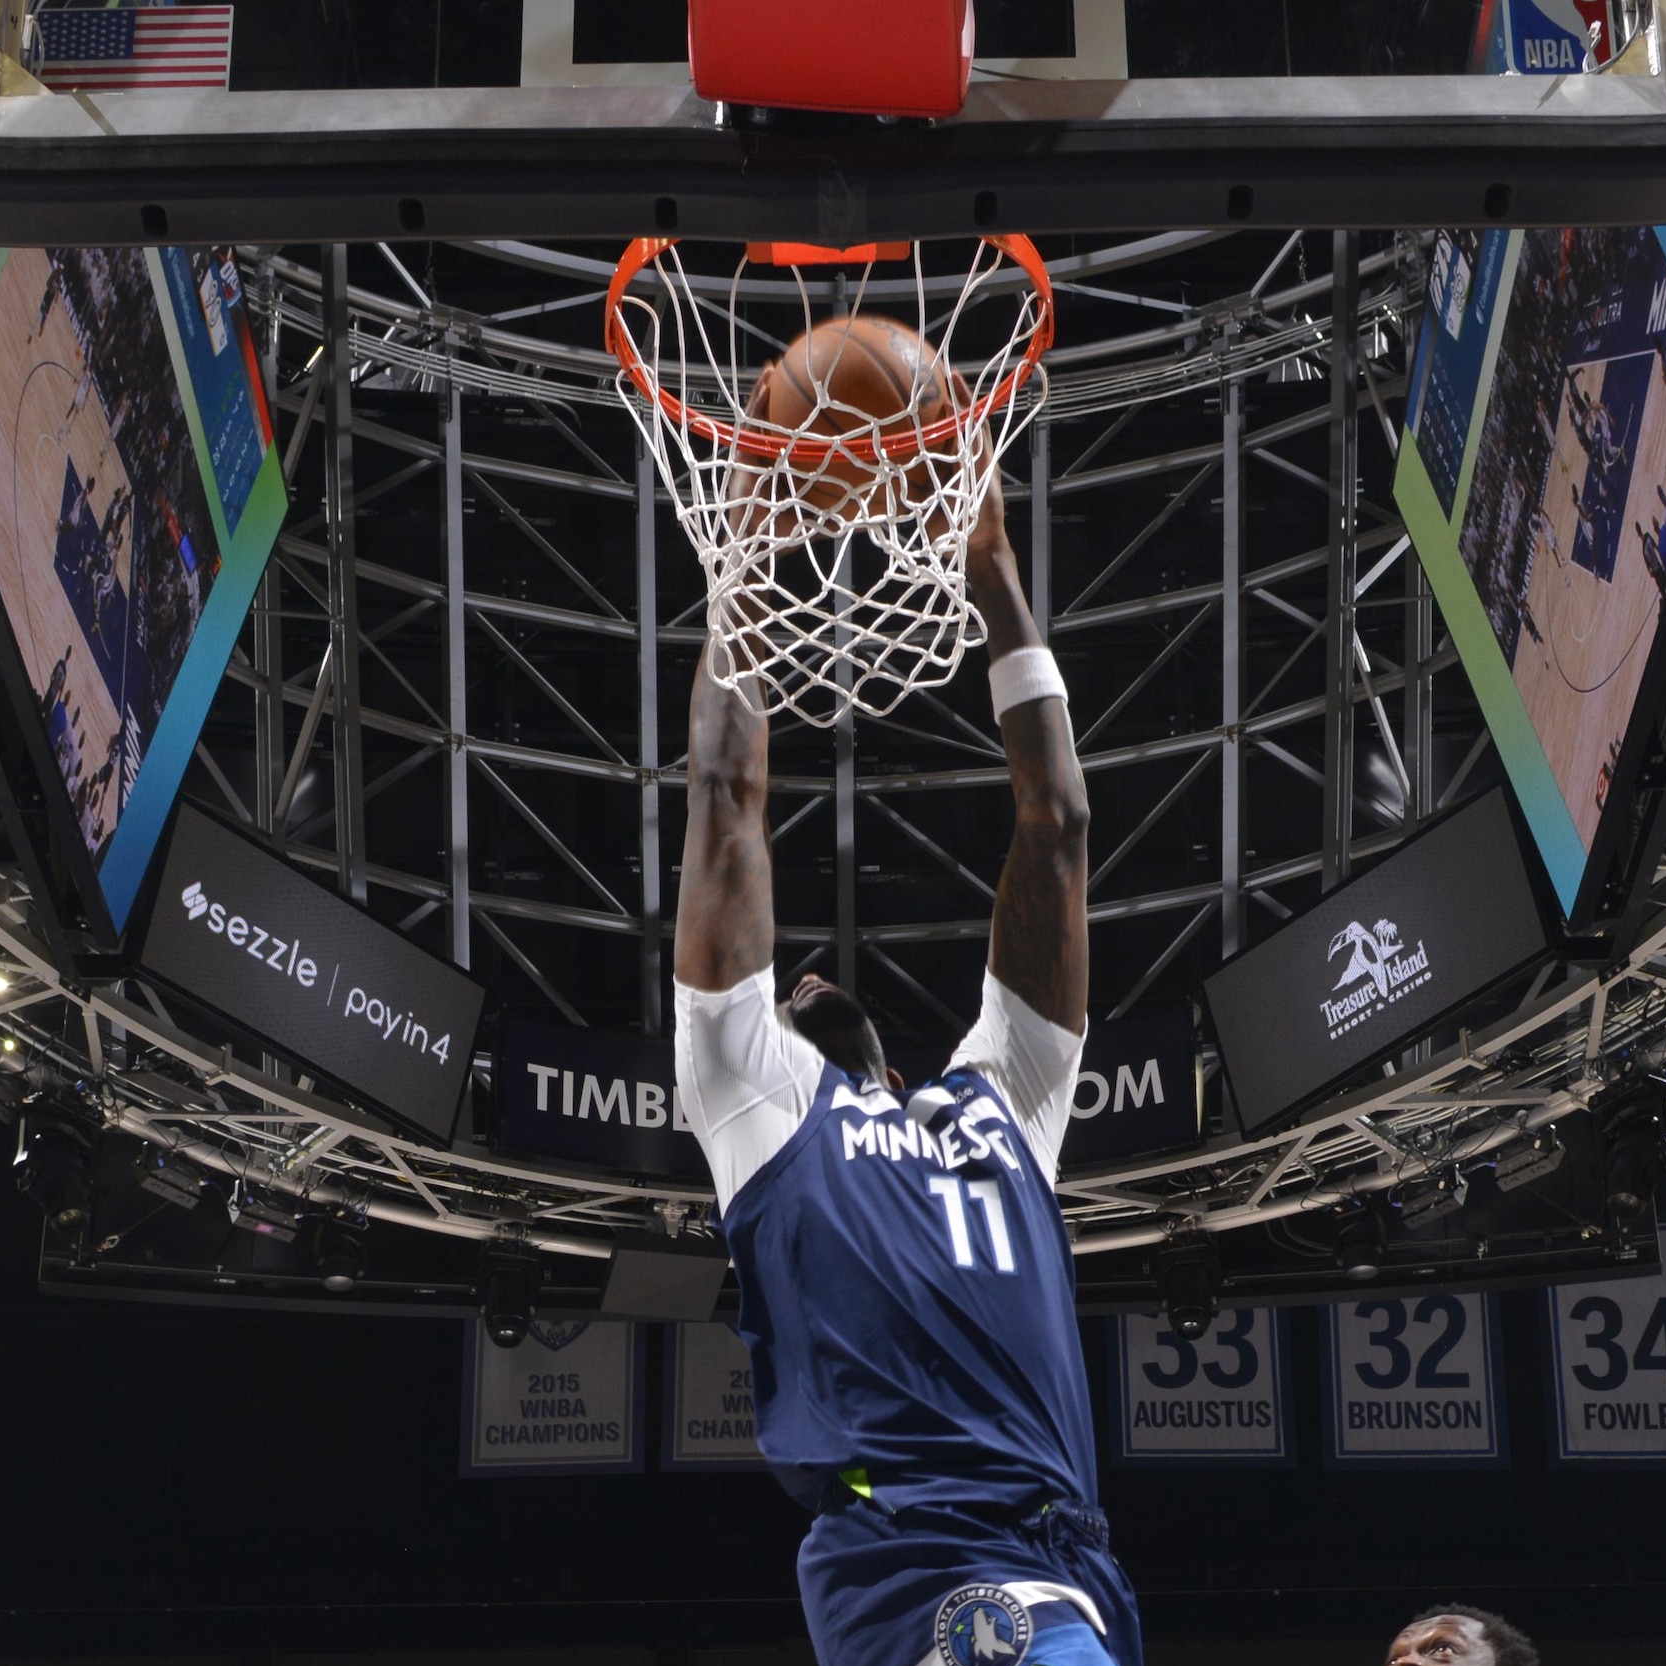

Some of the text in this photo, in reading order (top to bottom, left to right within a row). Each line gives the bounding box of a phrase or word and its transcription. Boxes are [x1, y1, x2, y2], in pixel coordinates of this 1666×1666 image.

[1524, 39, 1575, 68] NBA
[207, 902, 318, 987] sezzle
[1320, 939, 1429, 1028] Treasure Island
[1330, 972, 1432, 1040] RESORT CASINO
[925, 1173, 1018, 1276] 11
[1142, 1307, 1259, 1389] 33
[1354, 1296, 1470, 1389] 32
[520, 1399, 586, 1419] WNBA
[528, 1373, 580, 1393] 2015
[486, 1422, 620, 1445] CHAMPIONS
[1134, 1401, 1272, 1428] AUGUSTUS
[1349, 1402, 1482, 1430] BRUNSON
[953, 1586, 1027, 1642] TIMBERWOLVES
